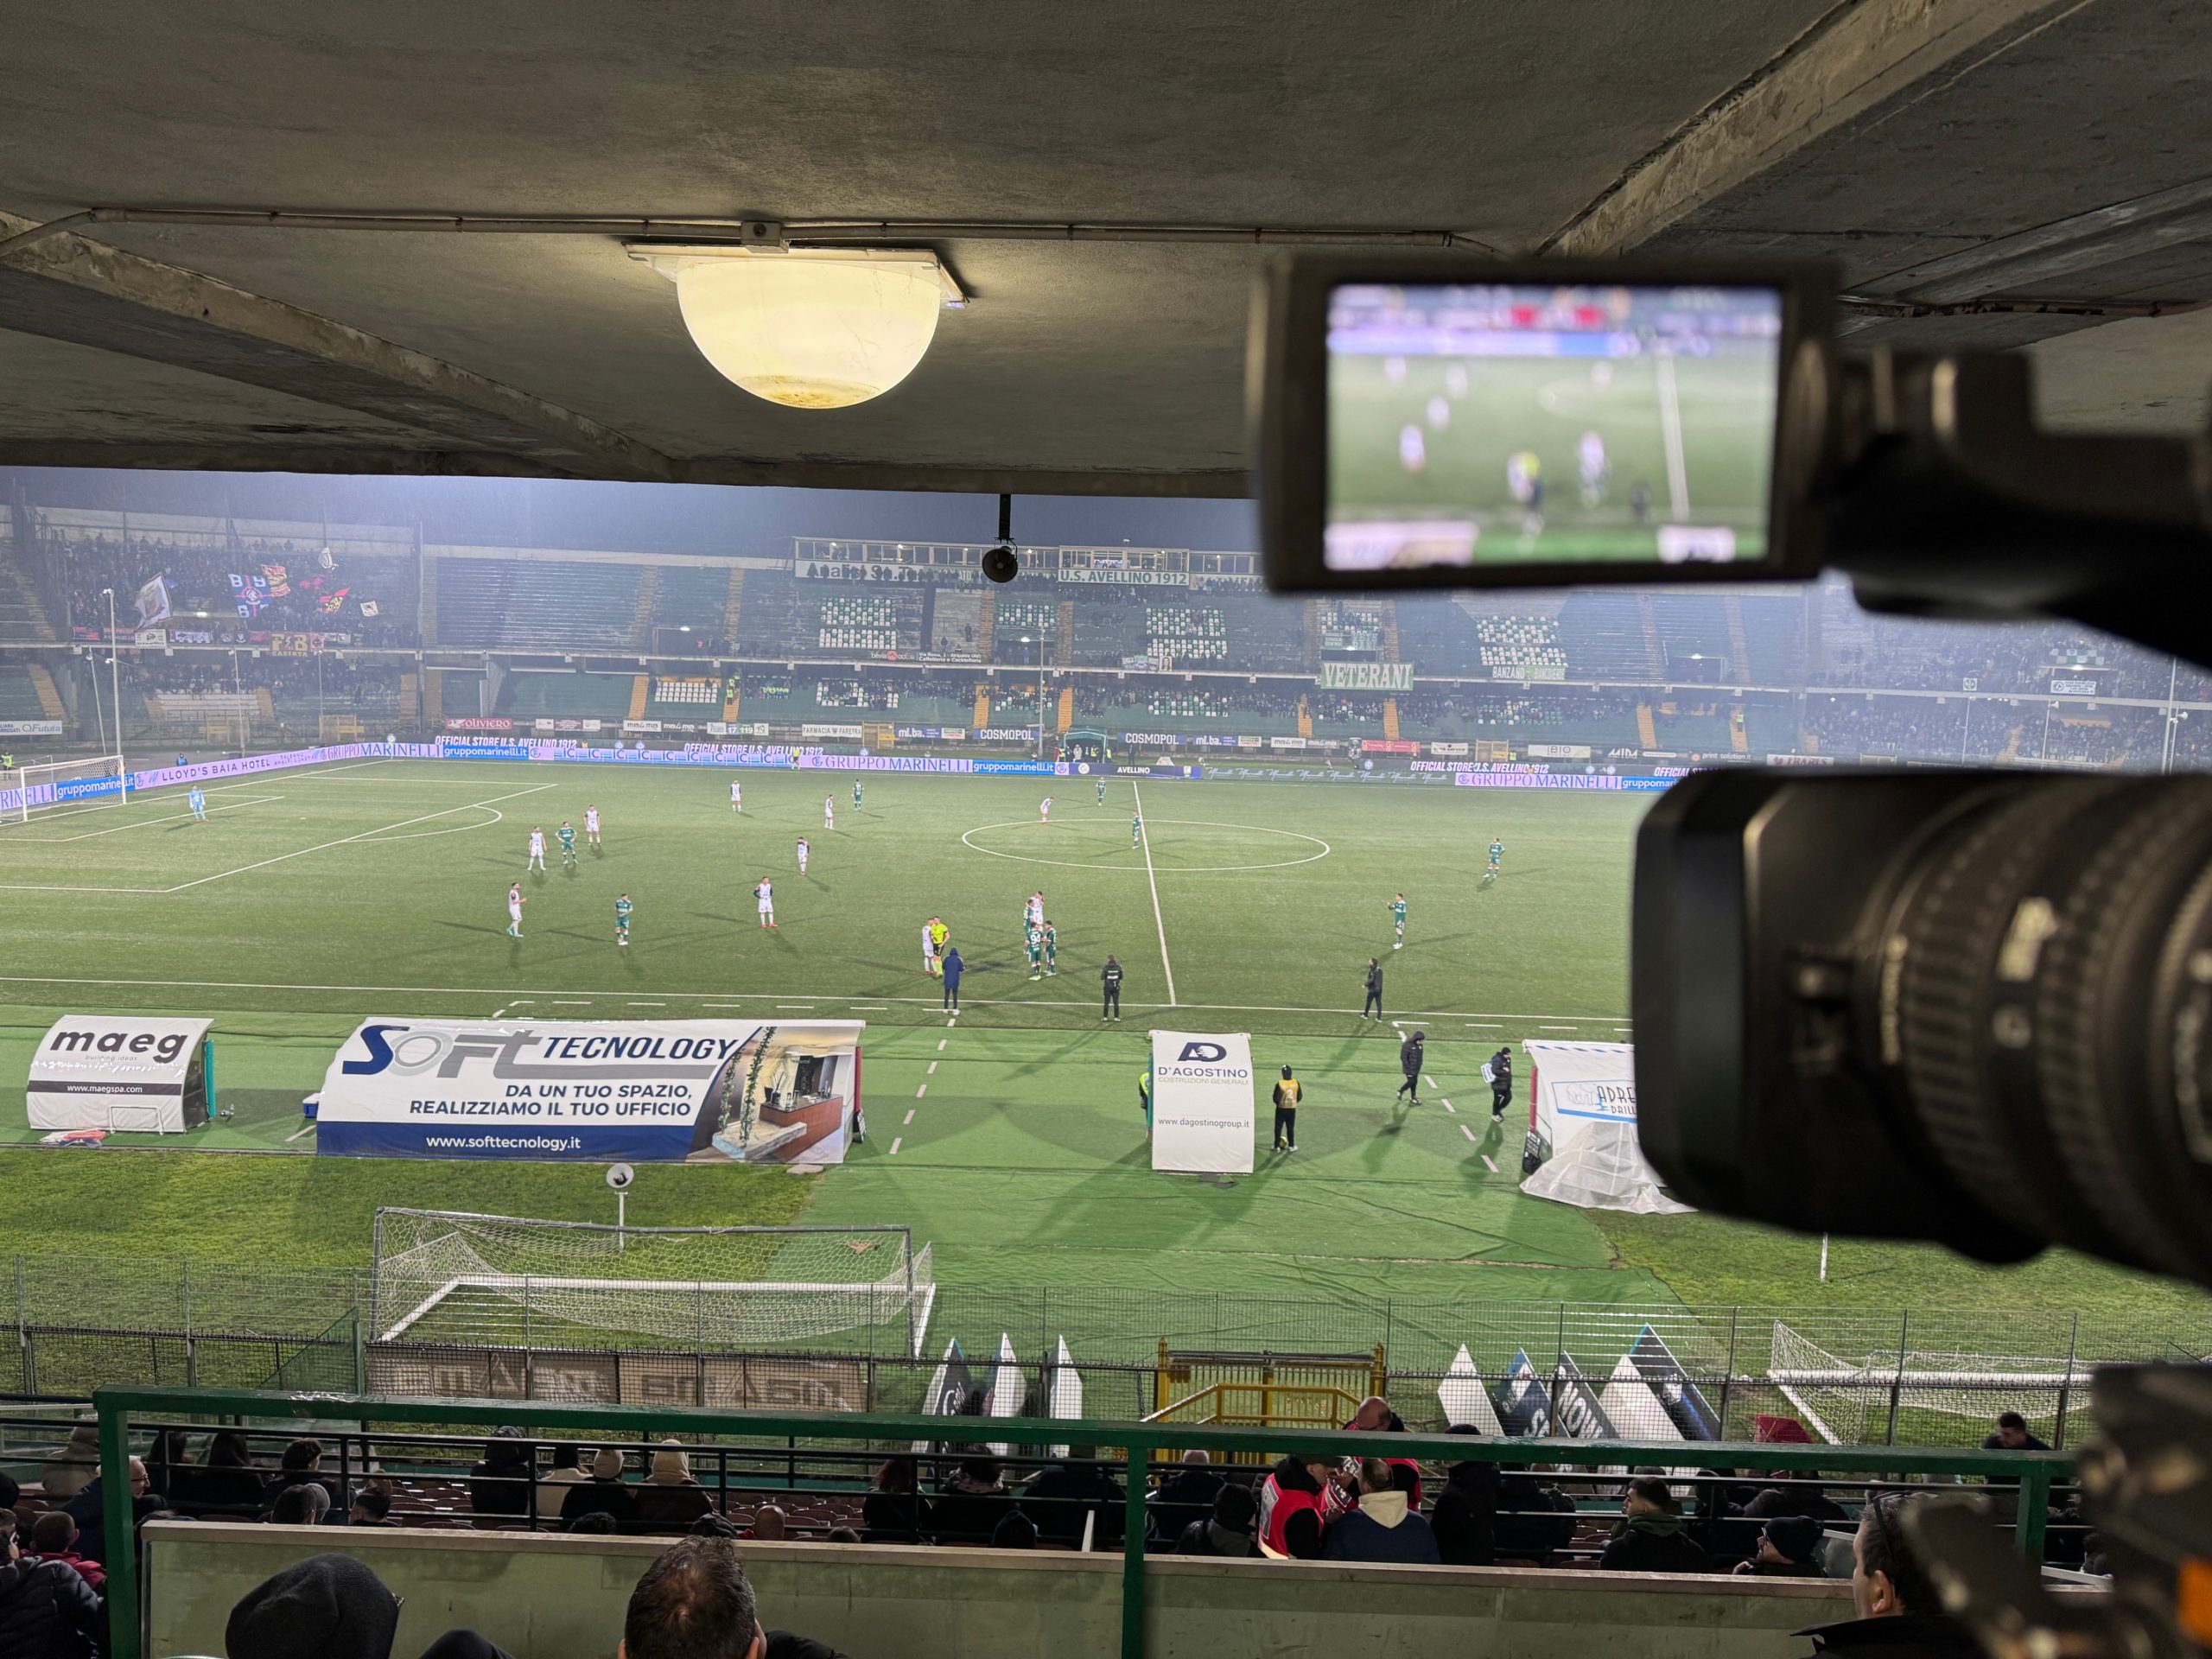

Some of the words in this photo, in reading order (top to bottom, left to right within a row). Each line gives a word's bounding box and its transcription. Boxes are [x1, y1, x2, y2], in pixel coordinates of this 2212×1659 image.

[1060, 570, 1085, 582] U.S.
[1088, 571, 1153, 583] AVELLINO
[1155, 573, 1188, 585] 1912
[1323, 662, 1413, 689] VETERANI
[465, 718, 511, 728] OLIVIERO
[435, 735, 472, 746] OFFICIAL
[472, 736, 499, 747] STORE
[518, 738, 557, 748] AVELLINO
[558, 740, 577, 748] 1912
[980, 729, 1034, 741] COSMOPOL
[1125, 733, 1179, 745] COSMOPOL
[327, 745, 359, 760] GRUPPO
[360, 743, 440, 757] MARINELLI
[444, 747, 528, 760] gruppomarinelli.it
[684, 743, 719, 753] OFFICIAL
[721, 743, 748, 753] STORE
[766, 746, 804, 755] AVELLIO
[805, 747, 823, 756] 1912
[162, 766, 208, 782] LLOYD'S
[212, 762, 238, 774] BAIA
[242, 759, 270, 771] HOTEL
[825, 756, 886, 770] GRUPPO
[889, 759, 969, 772] MARINELLI
[973, 762, 1054, 775] gruppomarinelli.it
[1410, 761, 1446, 772] OFFICIAL
[1447, 762, 1475, 772] STORE
[57, 775, 135, 798] gruppomarinei.it
[1471, 773, 1533, 786] GRUPPO
[1535, 774, 1618, 788] MARINELLI
[1030, 934, 1041, 944] 94
[49, 1031, 188, 1065] maeg
[543, 1036, 740, 1060] TECNOLOGY
[1158, 1066, 1249, 1078] D'AGOSTINO
[1158, 1076, 1210, 1084] COSTRUZIONI
[1211, 1077, 1249, 1085] GENERALI
[67, 1084, 143, 1094] www.maegspa.com
[505, 1084, 532, 1097] DA
[539, 1084, 567, 1097] UN
[573, 1084, 612, 1098] TUO
[617, 1084, 693, 1101] SPAZIO,
[1286, 1089, 1294, 1099] 2
[409, 1100, 542, 1116] REALIZZIAMO
[548, 1102, 564, 1116] IL
[570, 1102, 610, 1116] TUO
[615, 1103, 691, 1116] UFFICIO
[1158, 1117, 1249, 1129] www.dagostinogroup.it
[426, 1135, 581, 1151] www.softtecnology.it
